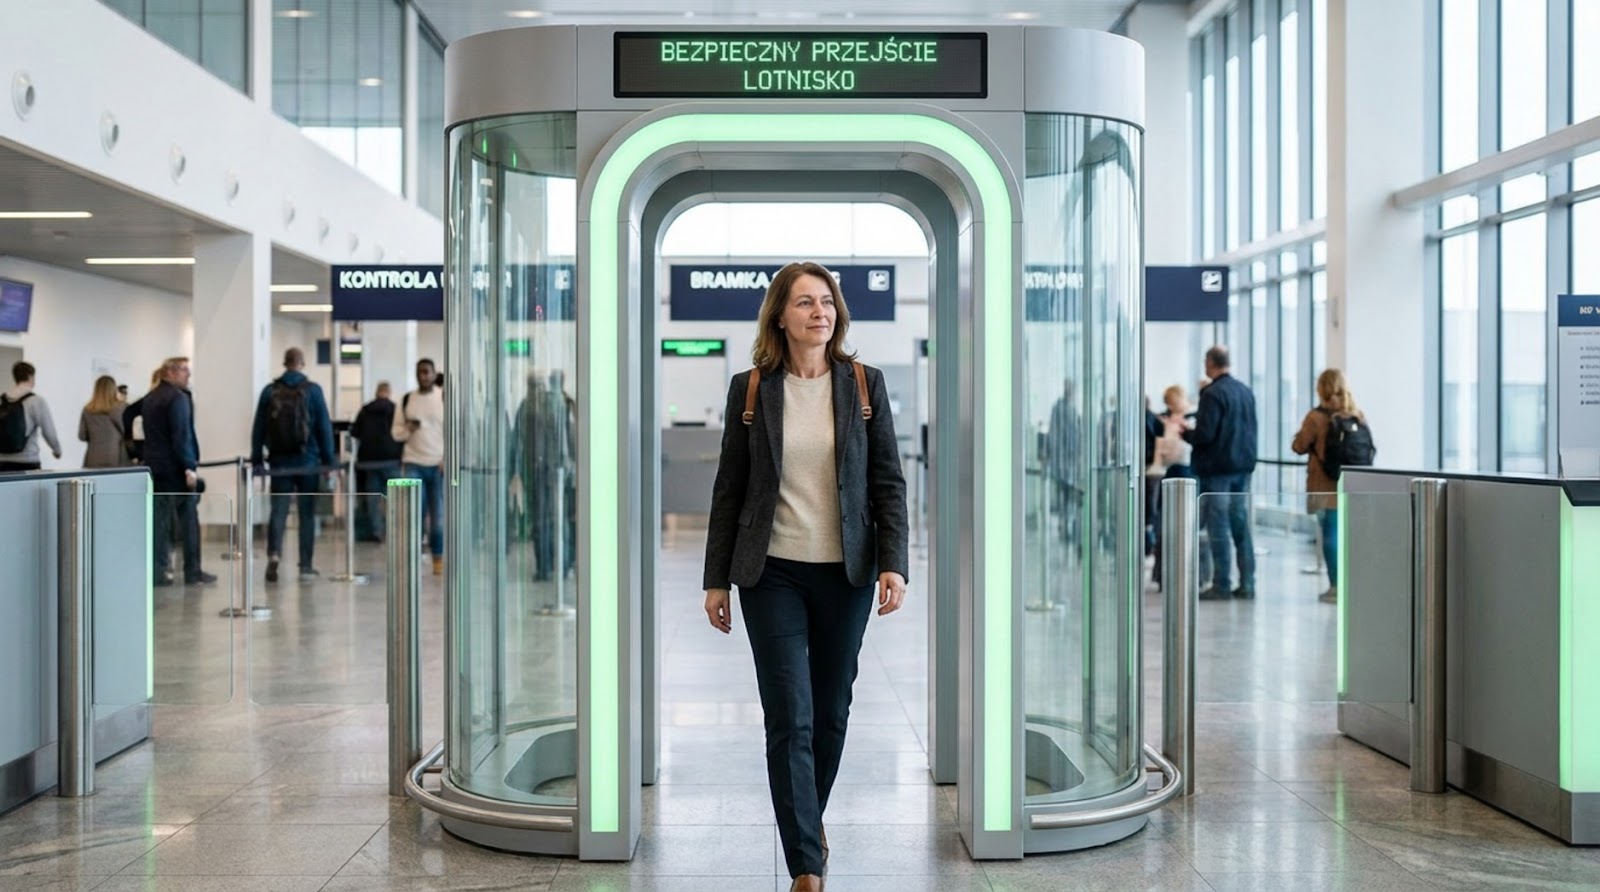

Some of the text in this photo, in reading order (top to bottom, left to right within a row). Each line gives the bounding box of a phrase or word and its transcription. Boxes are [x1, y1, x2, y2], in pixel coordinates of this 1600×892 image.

[661, 36, 938, 62] BEZPIECZNY PRZEJŚCIE
[743, 70, 856, 90] LOTNISKO
[340, 271, 438, 288] KONTROLA
[690, 271, 770, 289] BRAMKA
